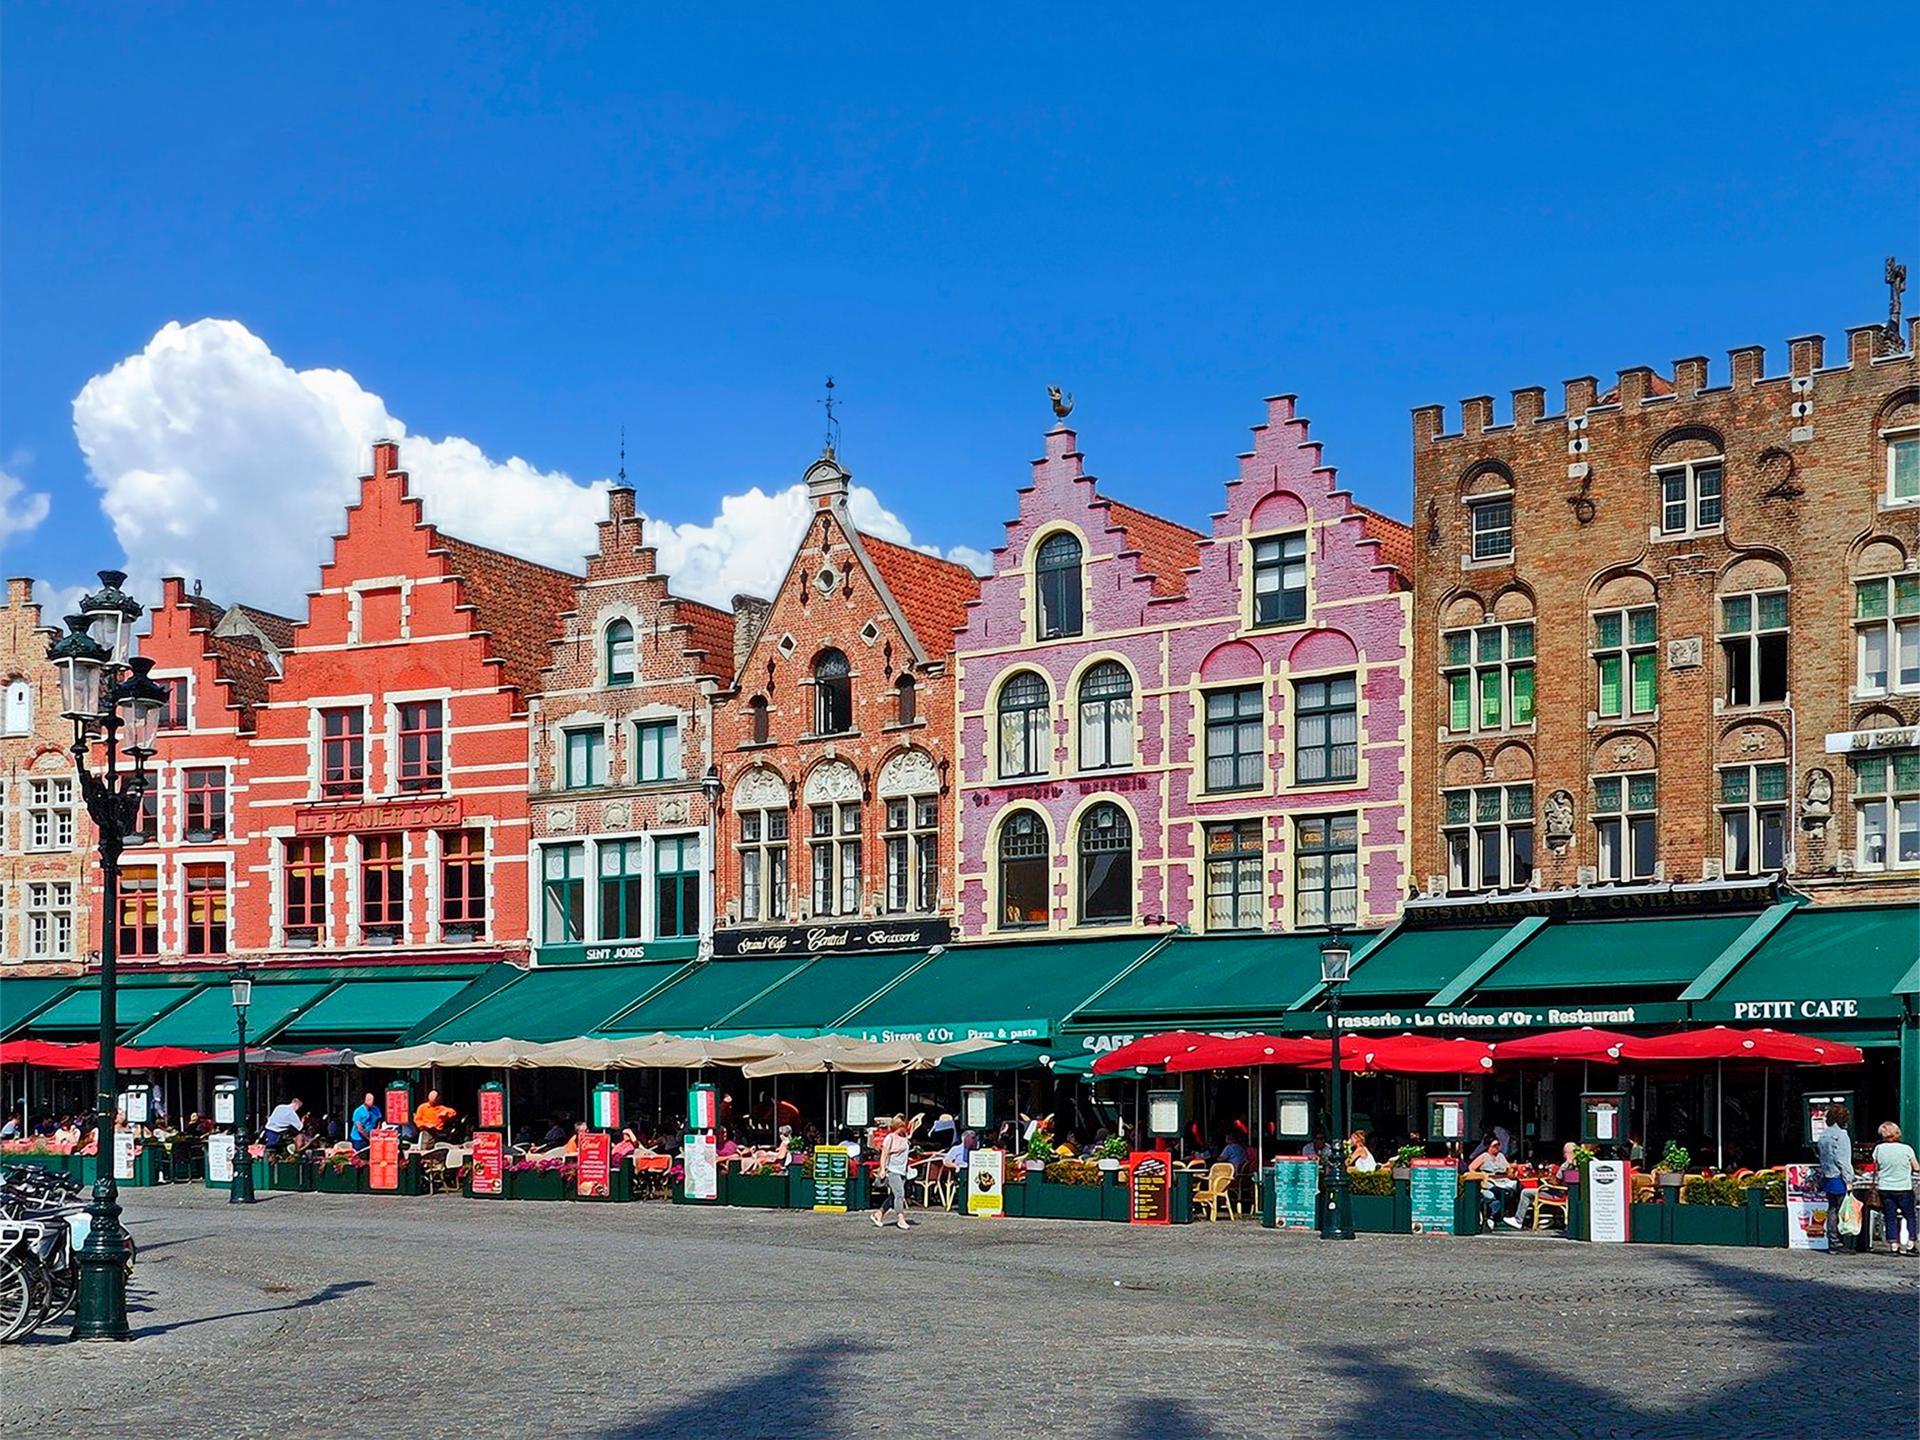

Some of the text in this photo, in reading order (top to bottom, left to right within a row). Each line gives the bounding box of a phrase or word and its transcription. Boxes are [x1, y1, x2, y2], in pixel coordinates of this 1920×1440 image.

[303, 804, 457, 831] LE PANIER D'OR
[1413, 901, 1552, 921] RESTAURANT
[1566, 898, 1596, 911] LA
[807, 928, 849, 951] Central
[867, 929, 920, 944] Brasserie
[586, 946, 645, 960] SINT JORIS
[1415, 1013, 1434, 1026] La
[1498, 1011, 1532, 1025] d'Or
[1548, 1007, 1635, 1024] Restaurant
[1734, 1000, 1858, 1019] PETIT CAFE
[862, 1031, 877, 1043] La
[927, 1028, 953, 1041] d'Or
[967, 1029, 994, 1039] Pizza
[997, 1028, 1007, 1038] &
[1010, 1027, 1038, 1039] pasta
